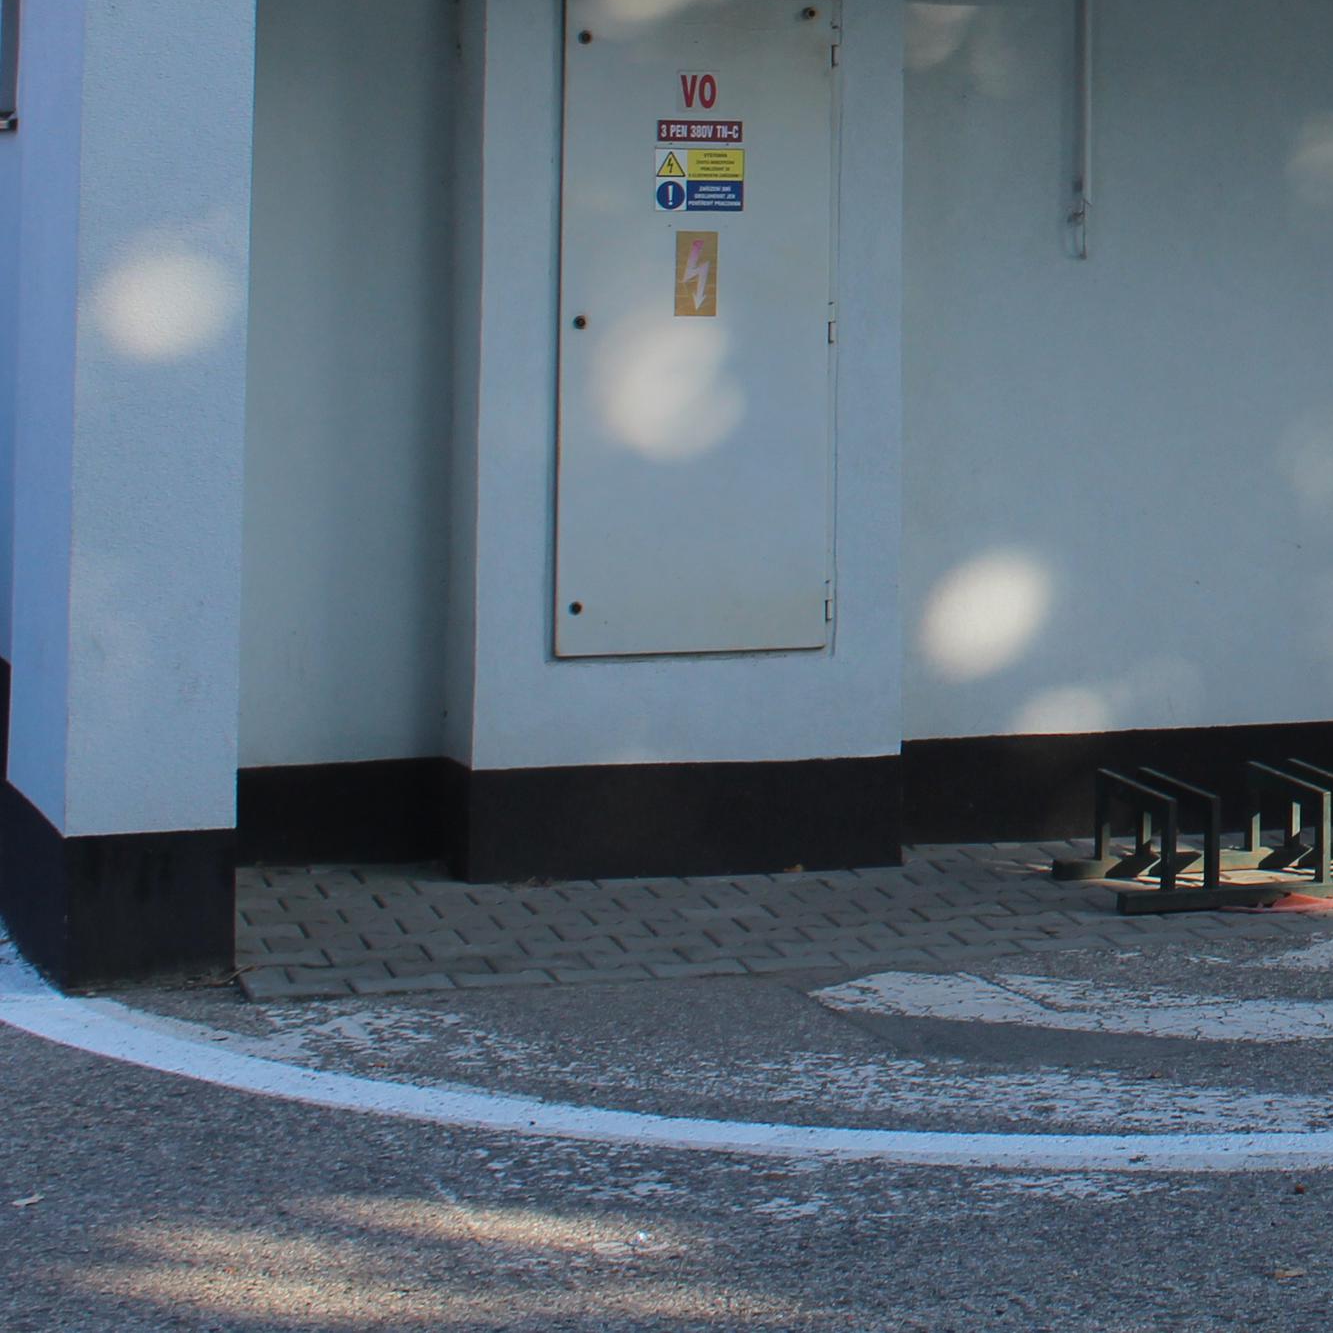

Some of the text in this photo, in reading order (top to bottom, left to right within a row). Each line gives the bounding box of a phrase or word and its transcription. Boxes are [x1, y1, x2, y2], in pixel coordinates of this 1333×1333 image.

[680, 74, 717, 109] VO
[660, 124, 667, 138] 3
[670, 124, 688, 138] PEN
